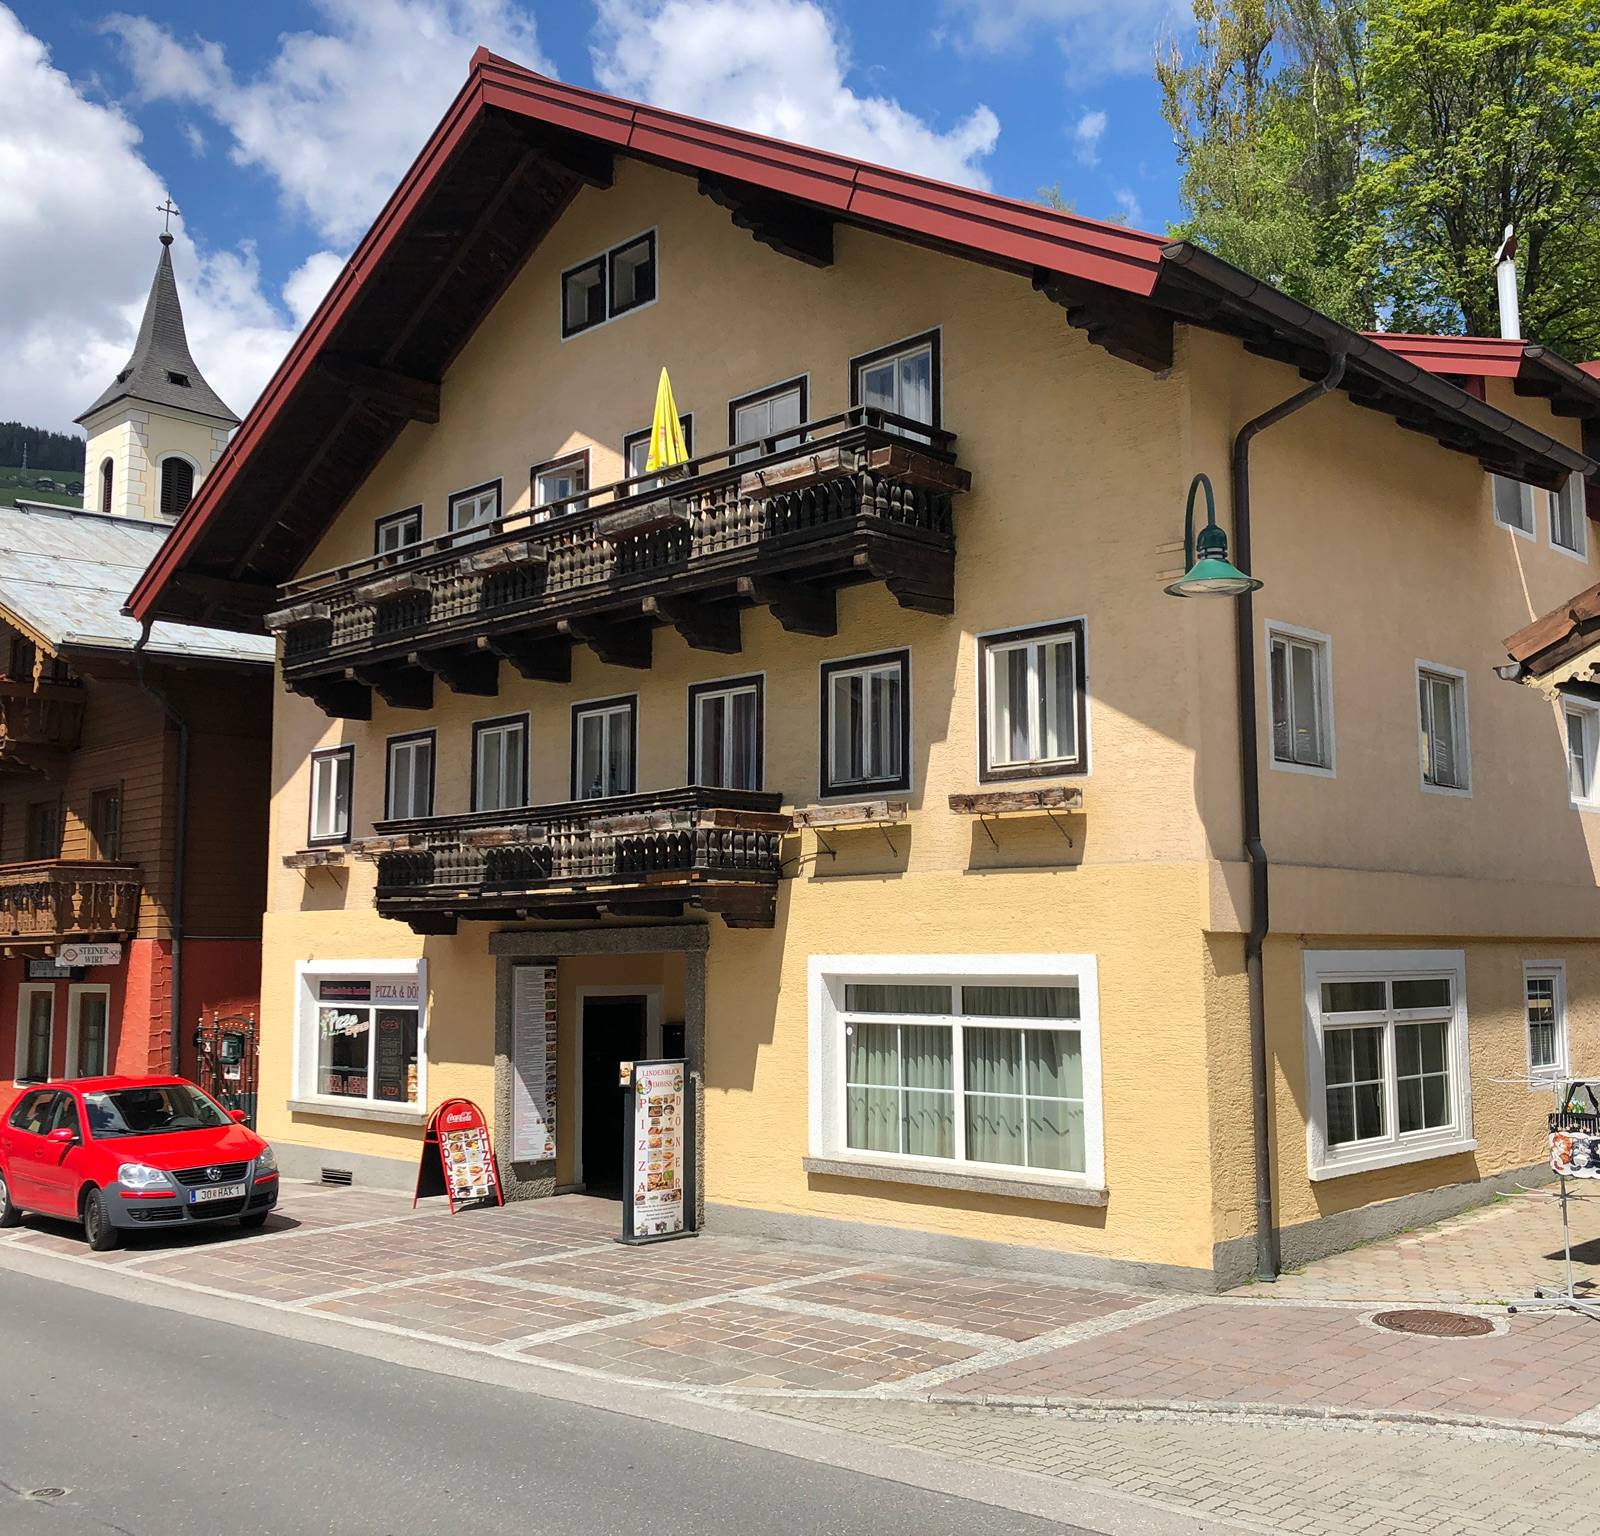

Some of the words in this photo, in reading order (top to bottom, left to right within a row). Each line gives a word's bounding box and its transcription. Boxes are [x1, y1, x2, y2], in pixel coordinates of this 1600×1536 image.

[79, 946, 109, 955] STEINER
[84, 955, 104, 964] WIRT
[375, 984, 397, 998] PIZZA
[399, 986, 405, 999] &
[638, 1098, 647, 1193] PIZZA
[478, 1127, 494, 1184] PIZZA
